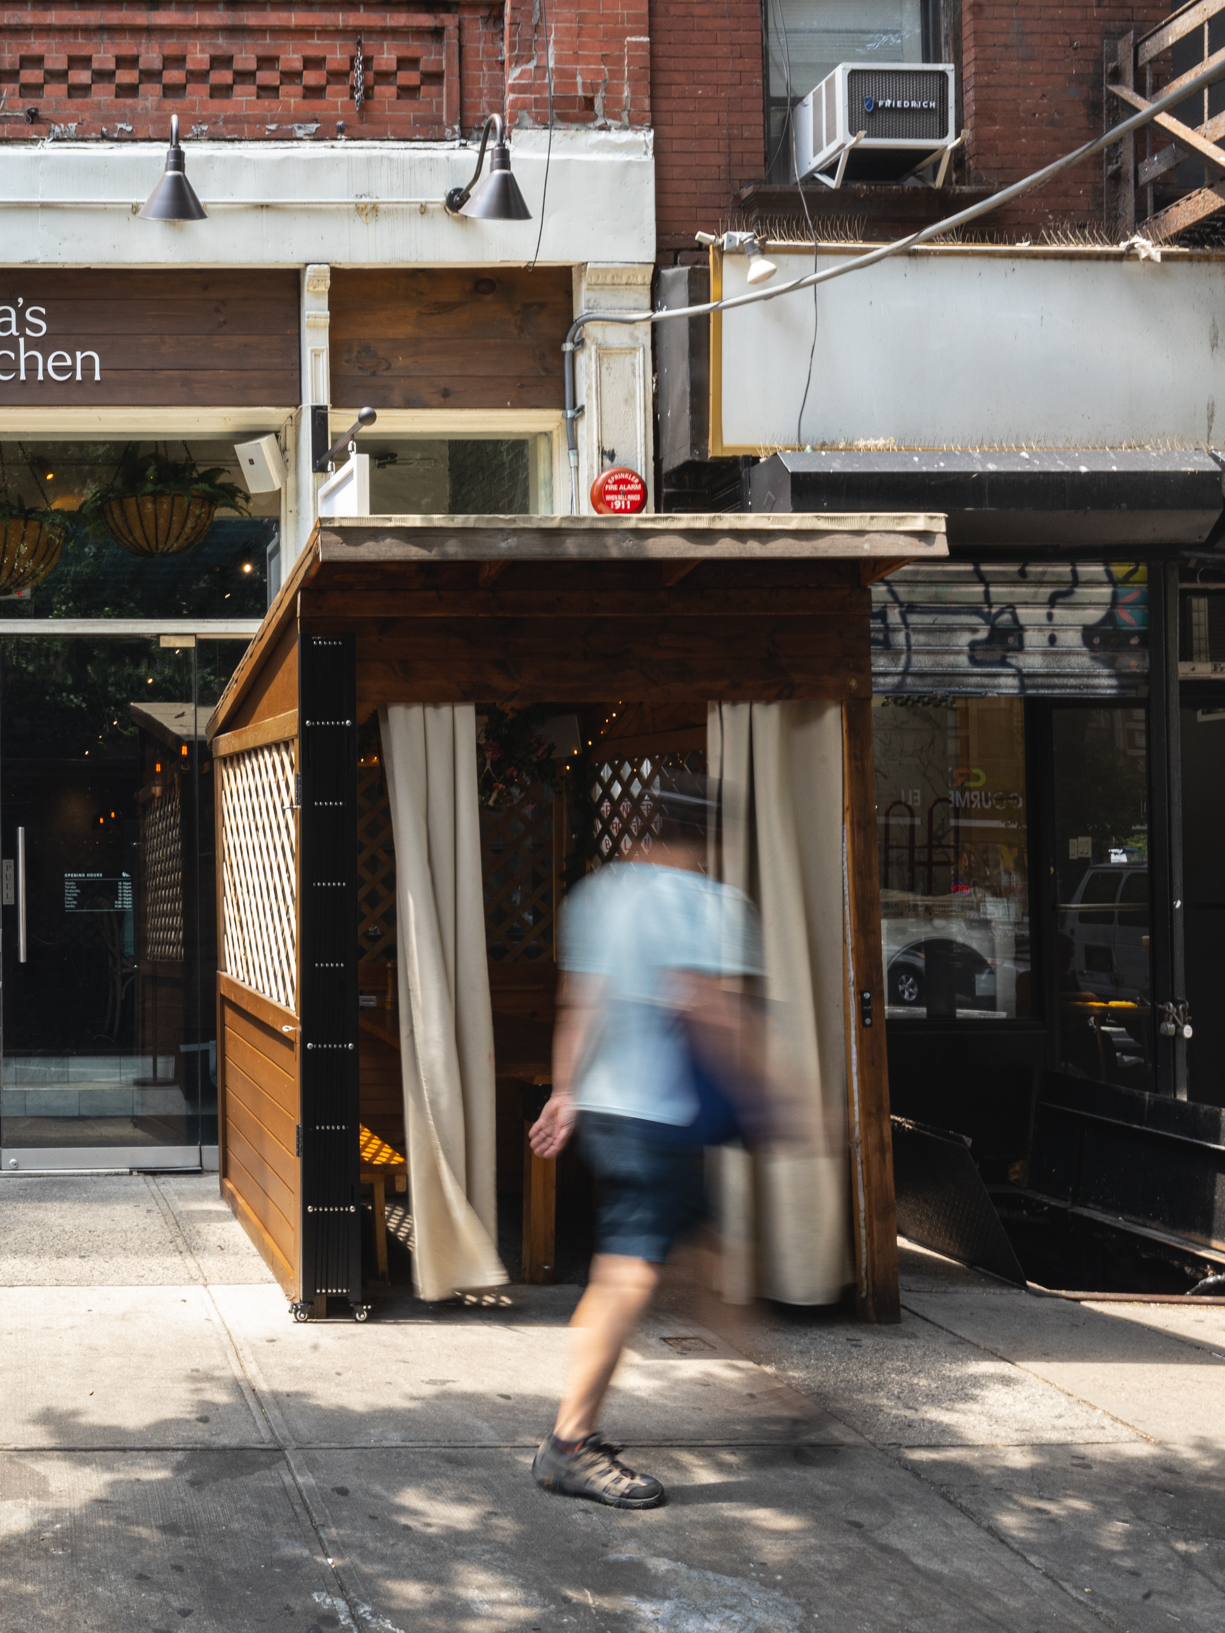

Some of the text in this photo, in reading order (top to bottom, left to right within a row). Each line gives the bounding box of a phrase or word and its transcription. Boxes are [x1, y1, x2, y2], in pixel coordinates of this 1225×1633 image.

[878, 99, 936, 109] FRIEDRICH
[607, 472, 640, 484] SPRINKLER
[614, 500, 631, 510] 911
